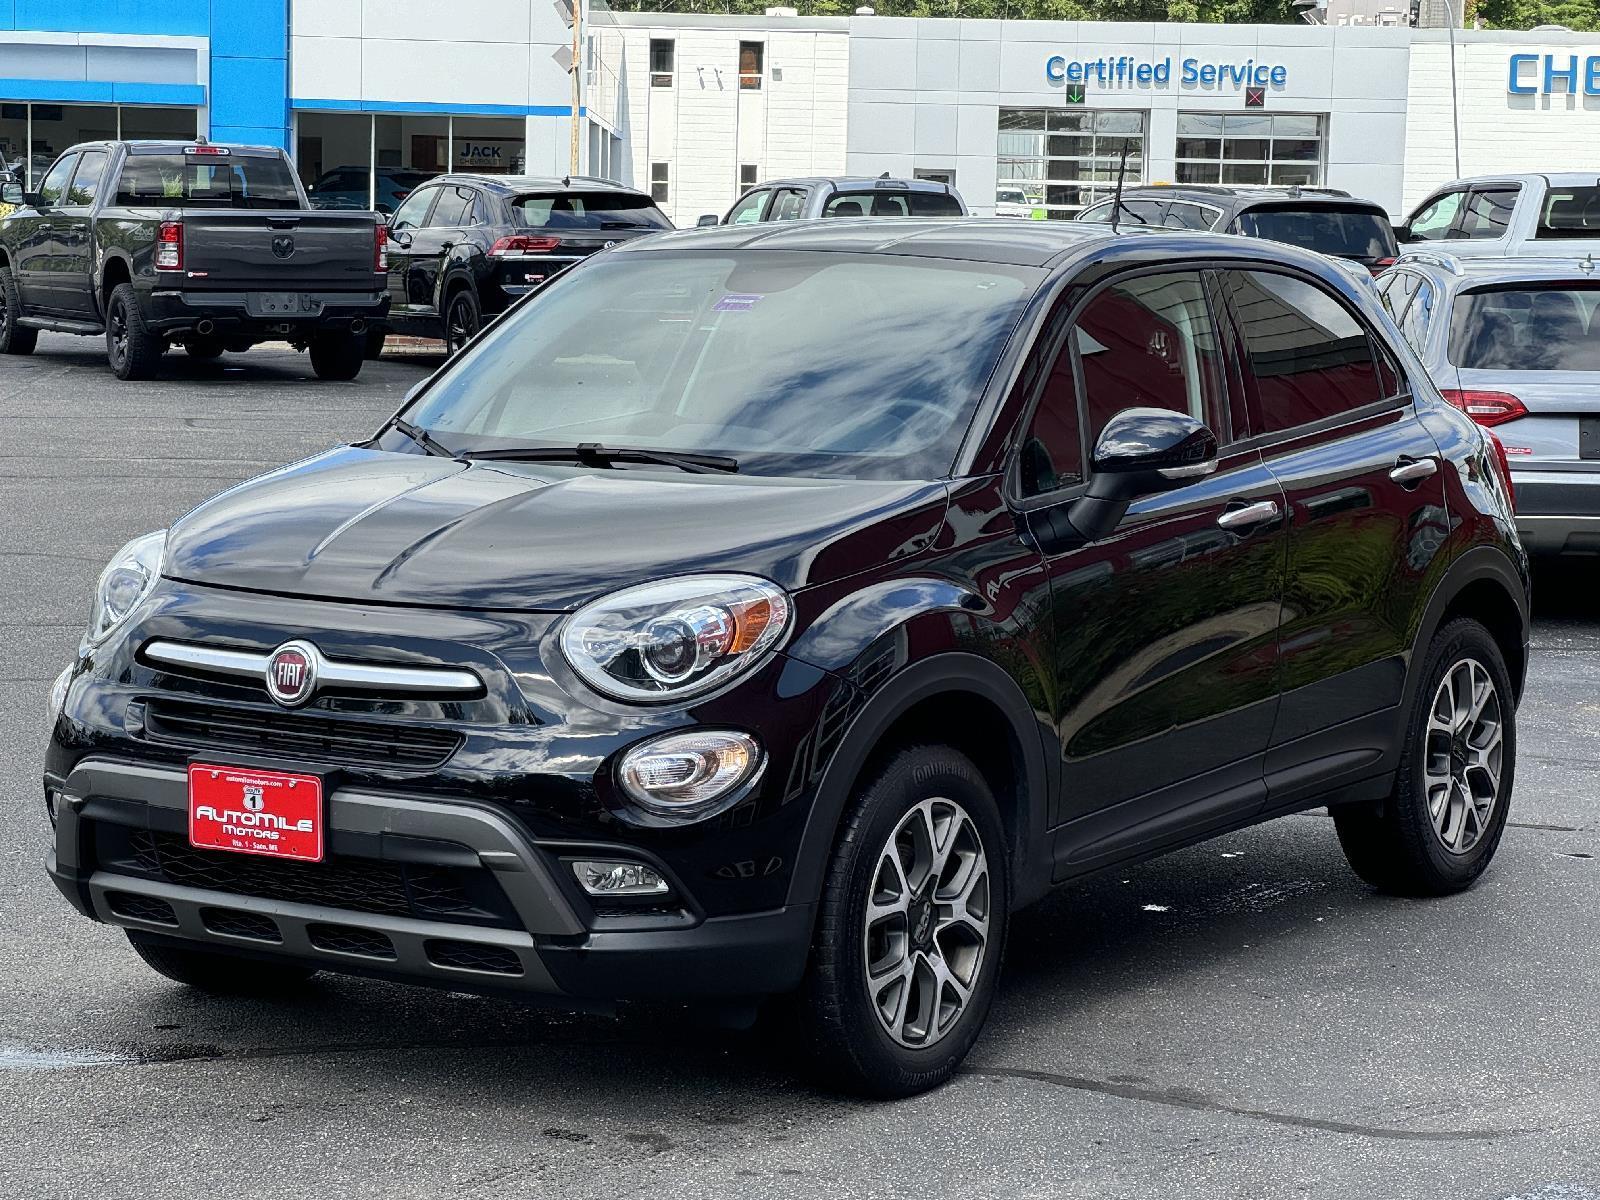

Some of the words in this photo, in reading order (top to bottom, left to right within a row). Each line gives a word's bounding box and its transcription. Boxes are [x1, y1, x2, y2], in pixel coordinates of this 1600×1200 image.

[1046, 55, 1171, 82] Certified
[1182, 58, 1287, 86] Service
[460, 143, 501, 158] JACK
[277, 662, 303, 687] FIAT
[250, 795, 257, 809] 1
[196, 805, 313, 833] AUTOMILE
[222, 824, 280, 840] MOTORS
